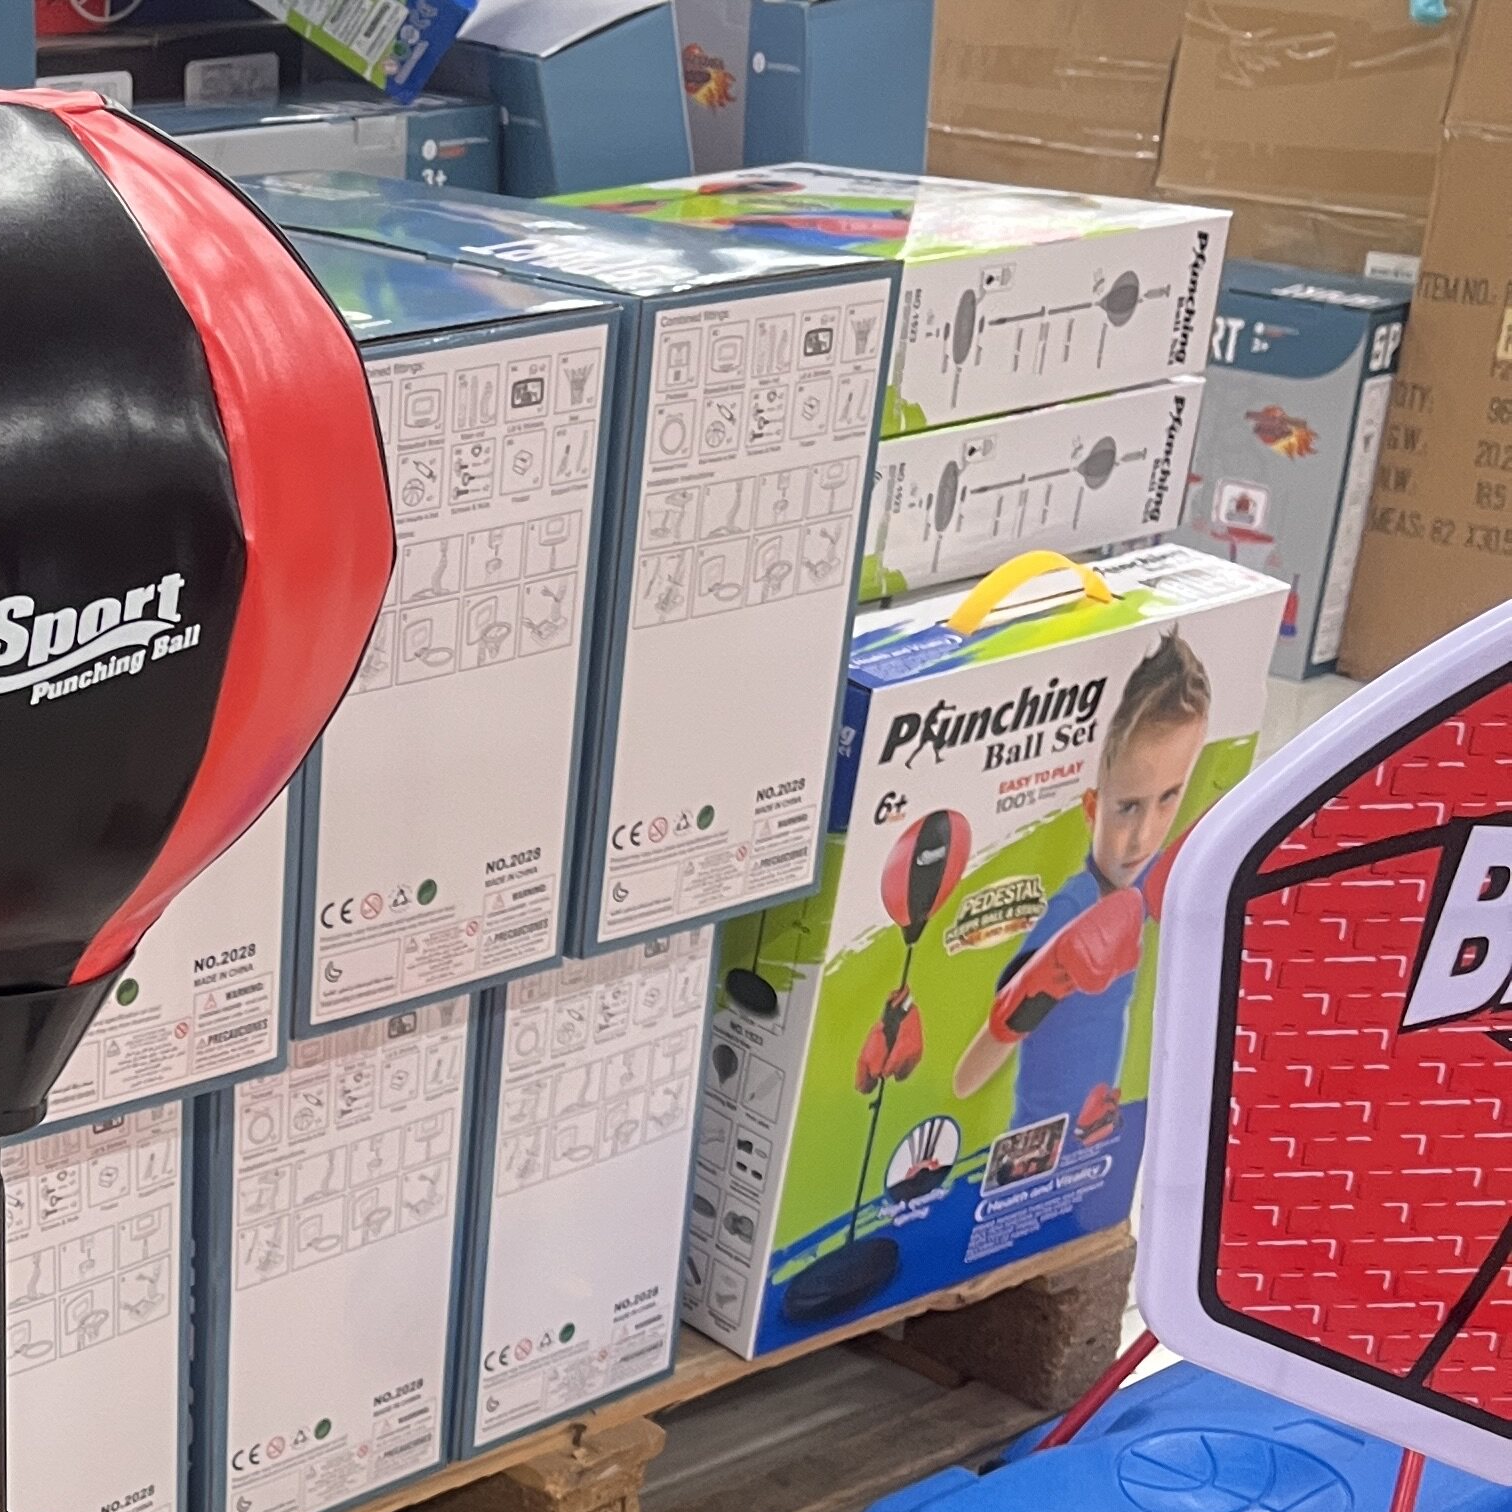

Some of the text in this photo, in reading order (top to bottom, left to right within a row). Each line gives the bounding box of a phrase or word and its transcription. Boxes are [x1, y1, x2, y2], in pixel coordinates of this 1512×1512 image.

[30, 624, 201, 706] Punching Ball
[982, 719, 1098, 772] Ball Set
[755, 778, 806, 803] NO.2028
[998, 776, 1031, 796] EASY
[1032, 771, 1050, 786] TO
[1051, 760, 1084, 783] PLAY
[874, 791, 908, 826] 6+
[485, 847, 542, 875] NO.2028
[960, 877, 1044, 919] PEDESTAL
[194, 943, 256, 973] NO.2028
